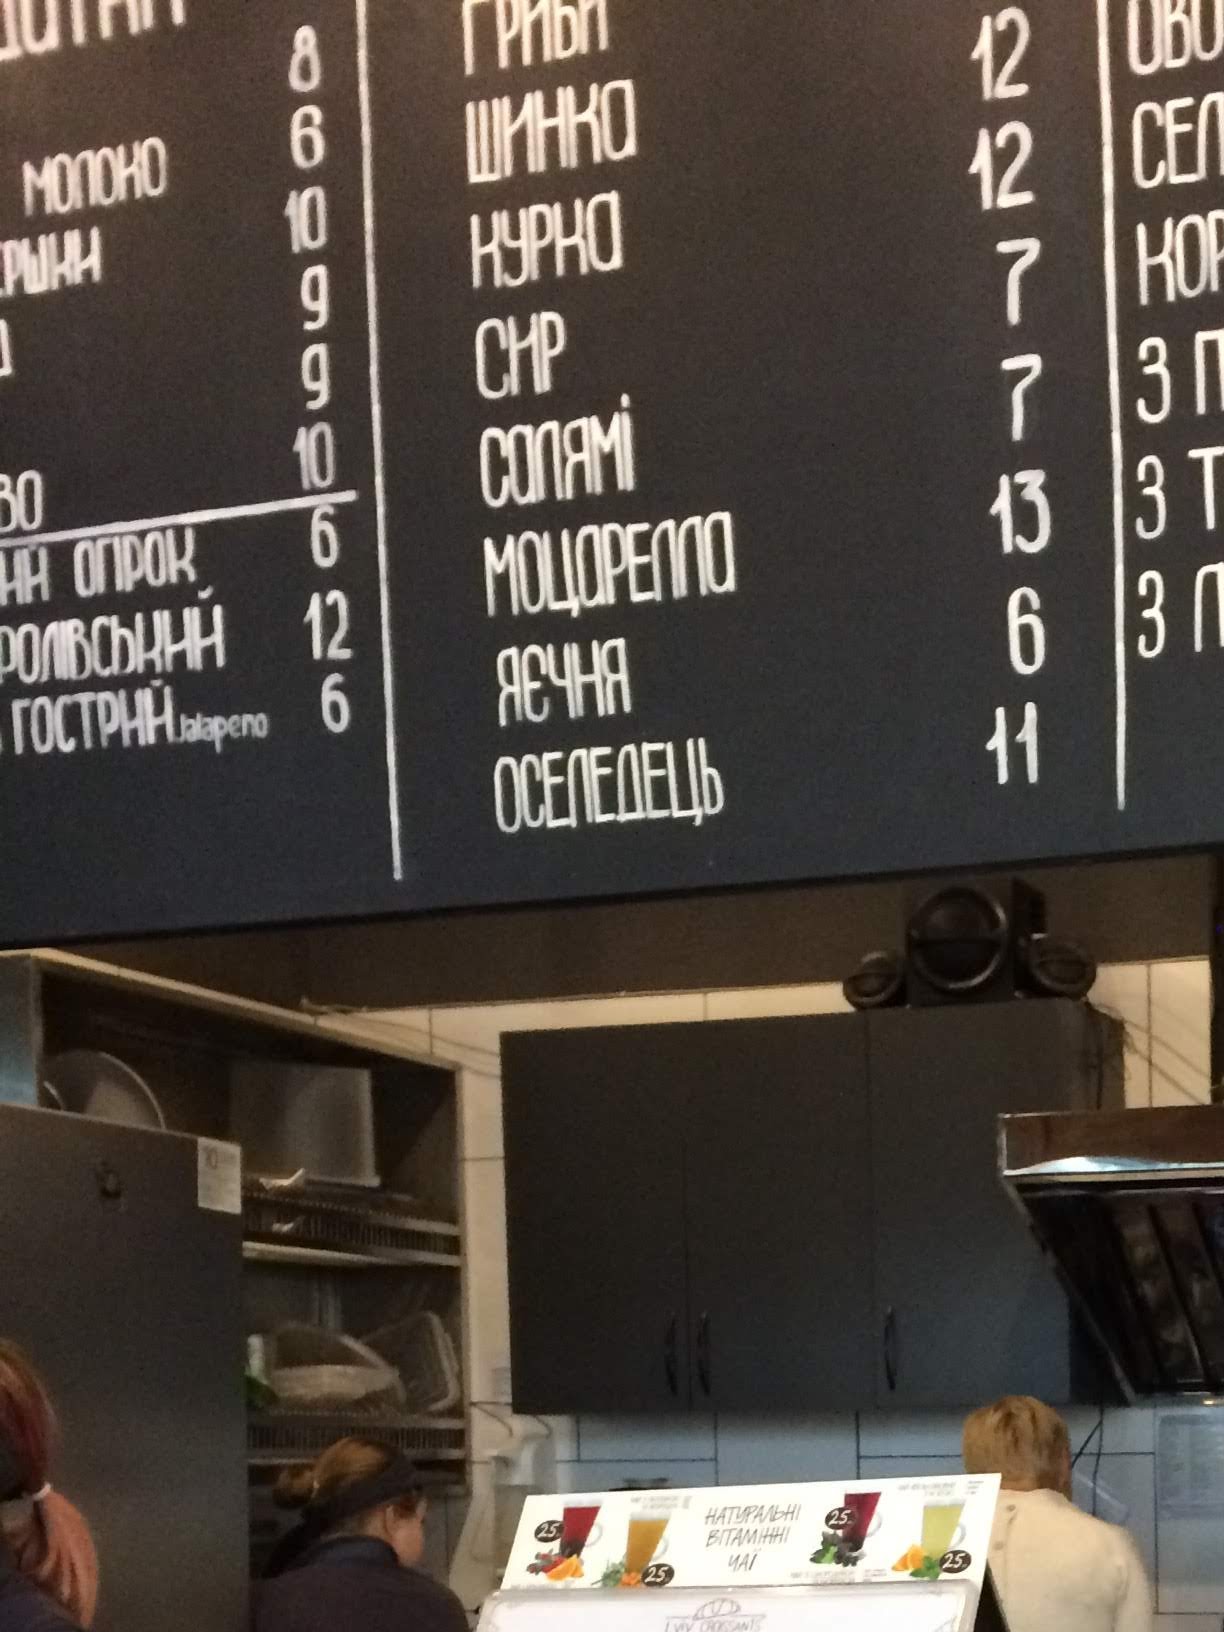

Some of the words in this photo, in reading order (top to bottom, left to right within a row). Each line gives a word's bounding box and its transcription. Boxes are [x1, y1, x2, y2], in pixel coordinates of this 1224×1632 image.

[287, 24, 322, 93] 8
[970, 6, 1031, 101] 12
[289, 104, 326, 170] 6
[465, 78, 638, 185] ШИНКА
[967, 120, 1036, 211] 12
[284, 185, 328, 254] 10
[469, 189, 624, 289] КУРКА
[300, 263, 330, 332] 9
[995, 237, 1042, 326] 7
[300, 342, 331, 411] 9
[474, 310, 568, 400] СИР
[1000, 353, 1043, 442] 7
[1135, 336, 1172, 425] З
[292, 421, 335, 491] 10
[479, 392, 637, 509] САЛЯМІ
[309, 503, 341, 569] 6
[989, 468, 1052, 555] 13
[1135, 454, 1167, 541] З
[483, 510, 738, 618] МОЦАРЕЛЛА
[303, 588, 354, 661] 12
[1006, 585, 1046, 676] 6
[1137, 569, 1166, 659] З
[320, 672, 351, 734] 6
[496, 636, 632, 728] ЯЄЧНЯ
[493, 736, 725, 834] ОСЕЛЕДЕЦЬ
[985, 701, 1039, 785] 11
[539, 1521, 557, 1540] 25
[705, 1503, 801, 1525] НАТУРАЛЬНІ
[705, 1526, 791, 1548] ВІТАМІННІ
[829, 1509, 852, 1526] 25
[645, 1567, 667, 1584] 25
[943, 1553, 965, 1570] 25
